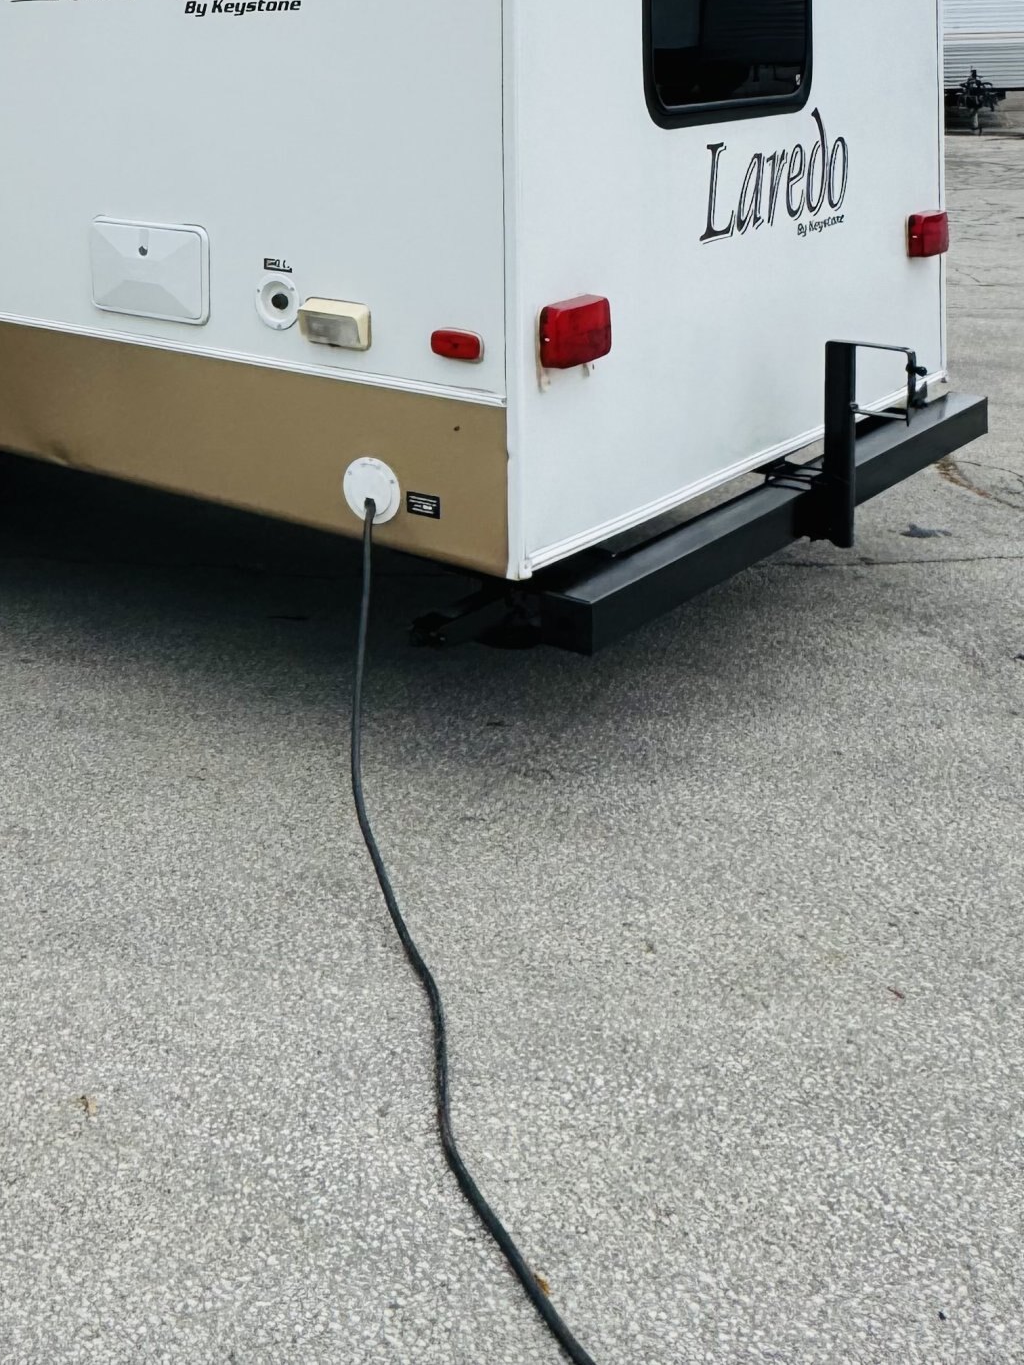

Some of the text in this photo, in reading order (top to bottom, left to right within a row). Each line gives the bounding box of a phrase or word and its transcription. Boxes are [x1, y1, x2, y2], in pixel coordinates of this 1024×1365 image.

[184, 0, 301, 17] By Keystone
[699, 107, 849, 245] Laredo
[797, 222, 807, 237] By
